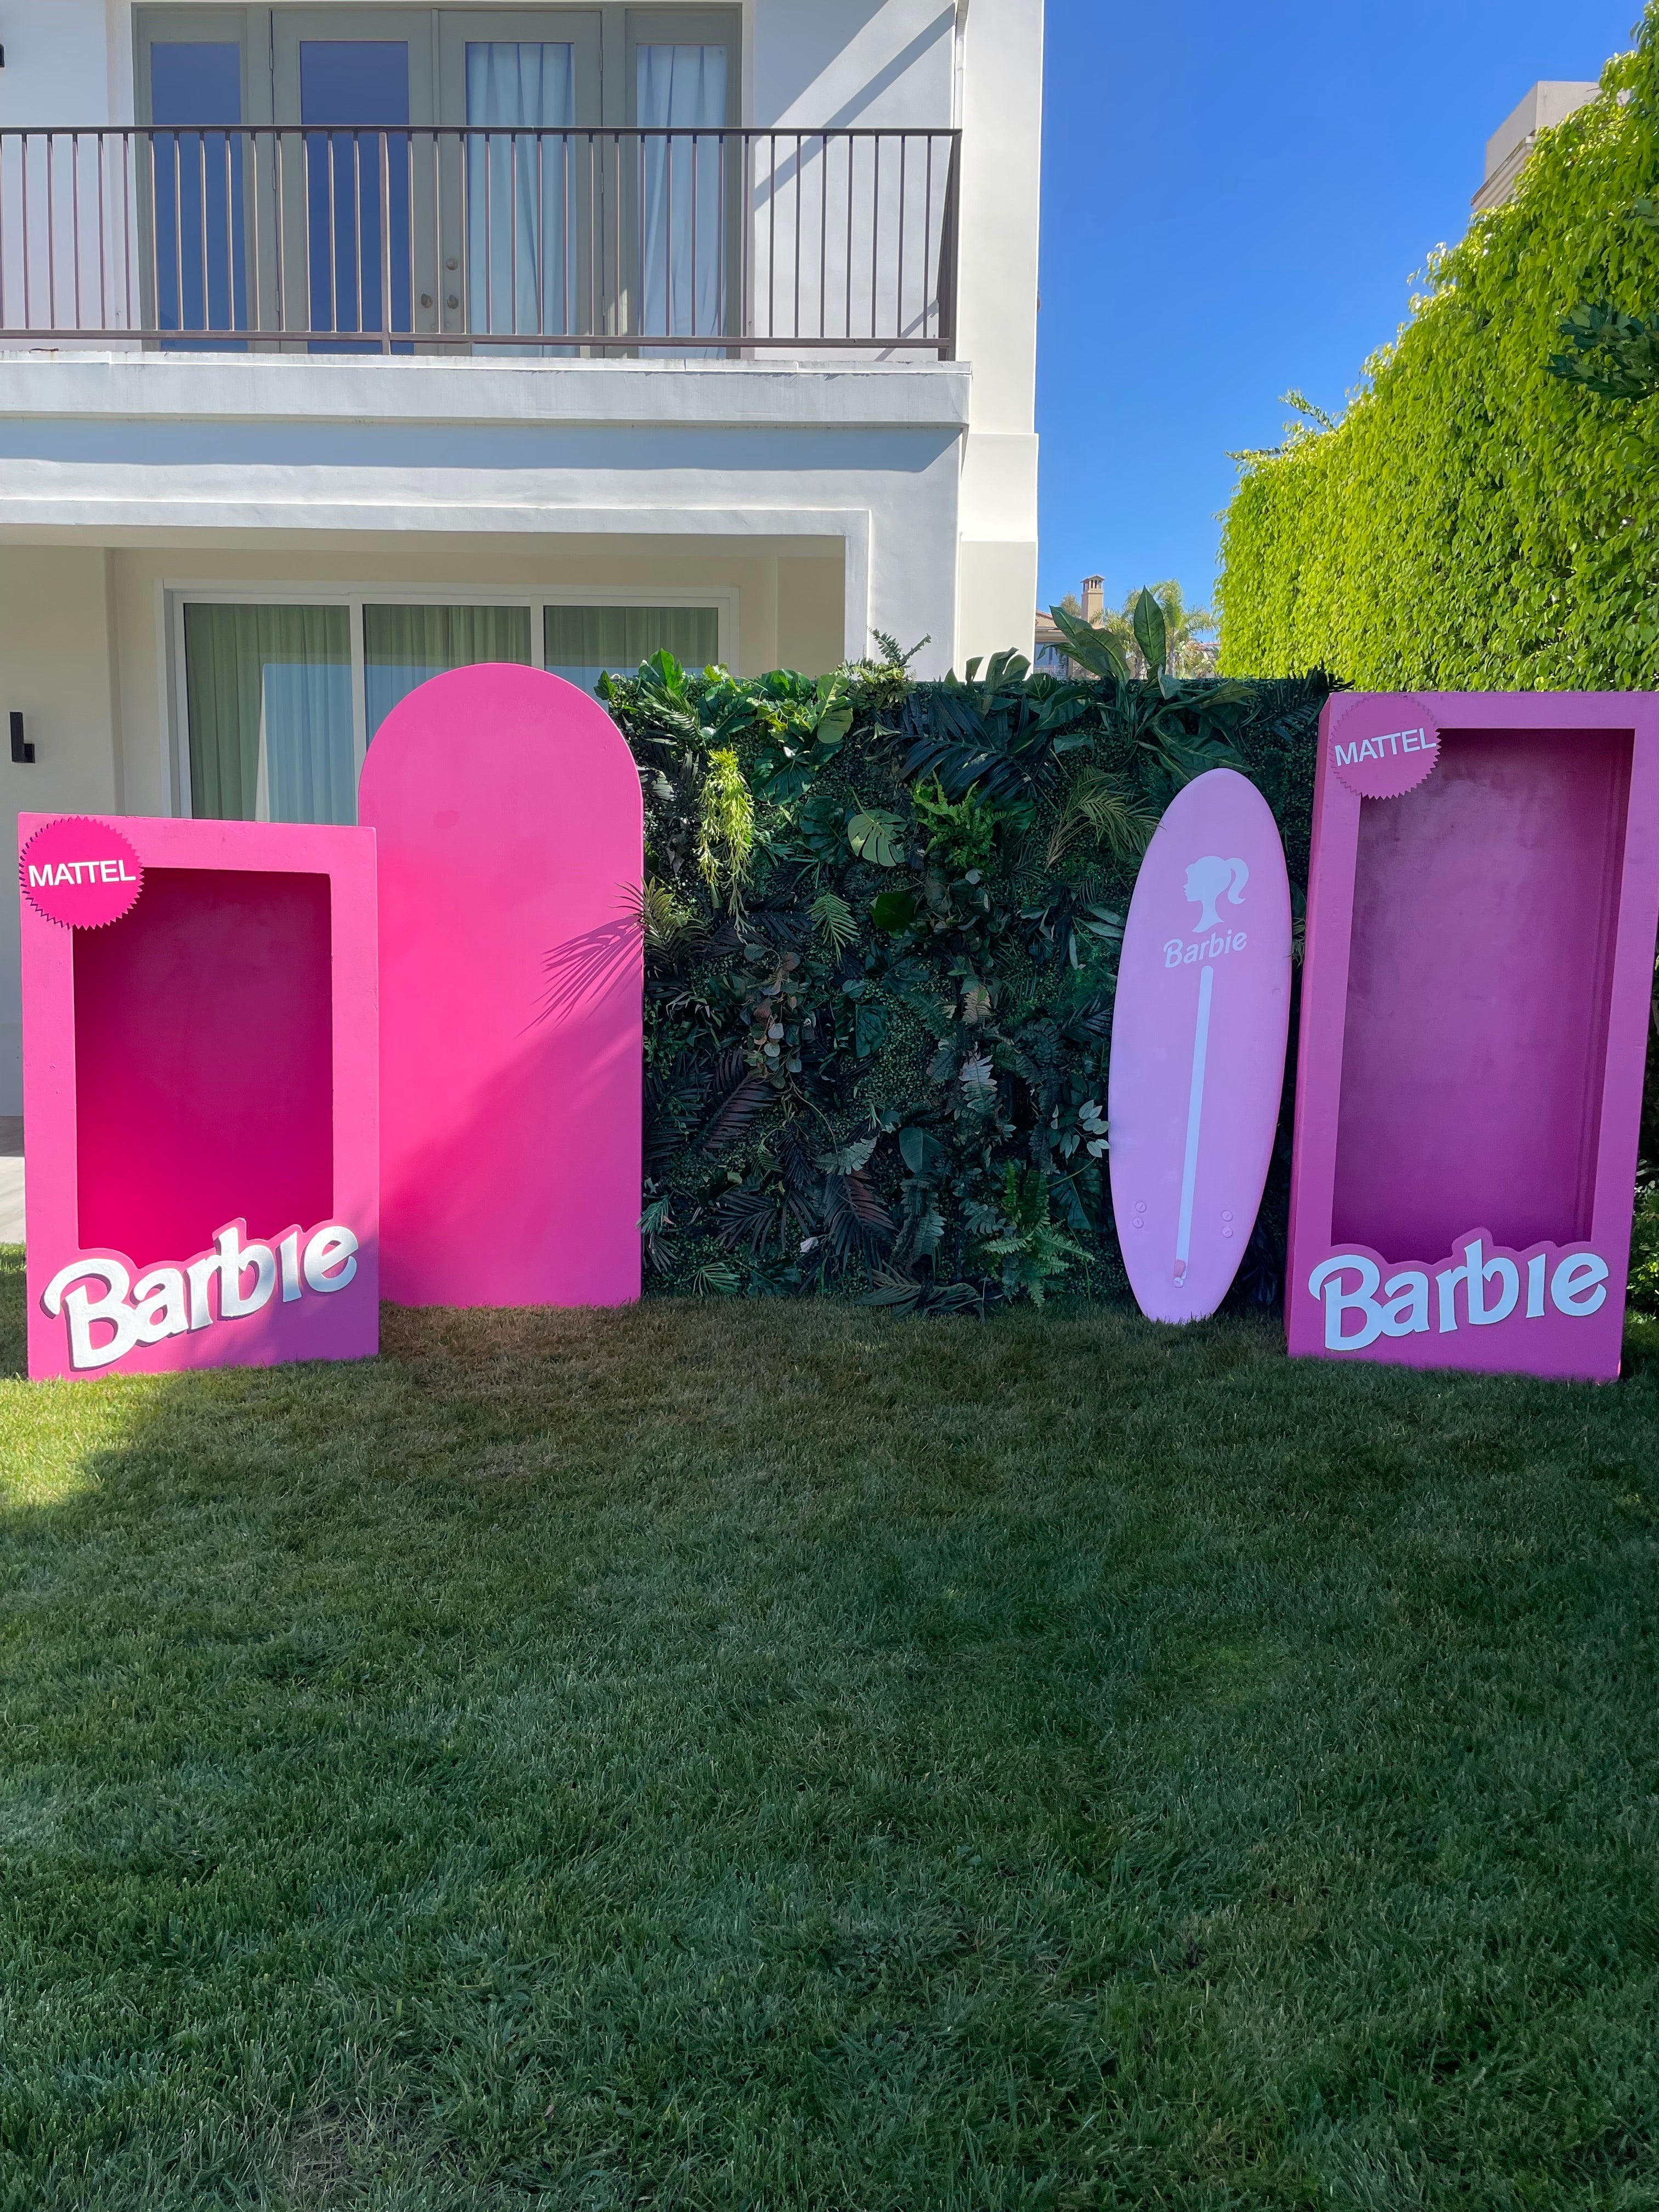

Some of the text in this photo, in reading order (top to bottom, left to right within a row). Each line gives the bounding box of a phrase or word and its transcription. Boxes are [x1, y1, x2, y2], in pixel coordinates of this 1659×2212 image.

[1334, 727, 1437, 766] MATTEL
[28, 860, 137, 887] MATTEL
[1163, 929, 1248, 968] Barbie
[43, 1226, 359, 1369] Barbie
[1308, 1238, 1609, 1351] Barbie
